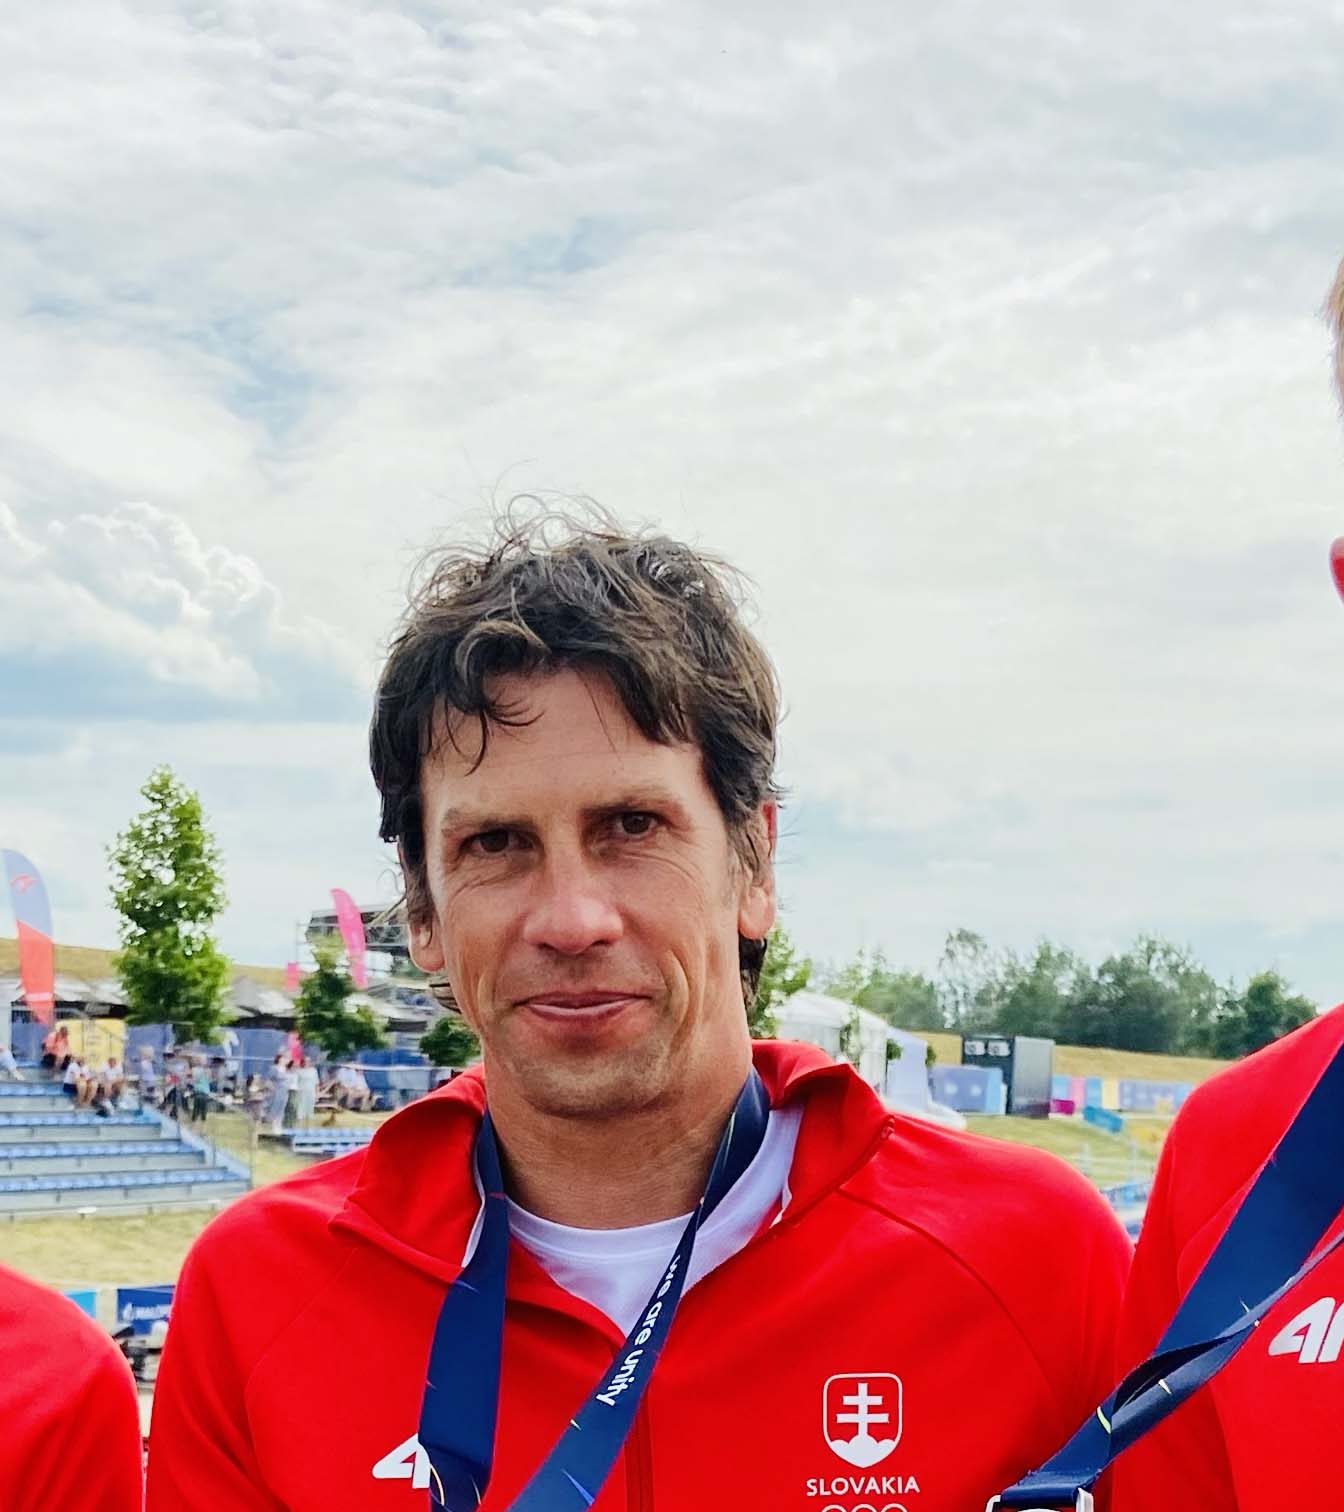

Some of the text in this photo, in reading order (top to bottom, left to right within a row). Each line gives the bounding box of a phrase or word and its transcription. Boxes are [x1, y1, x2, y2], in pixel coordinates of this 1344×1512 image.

[634, 1301, 663, 1346] are
[595, 1349, 644, 1407] unity
[806, 1475, 920, 1497] SLOVAKIA
